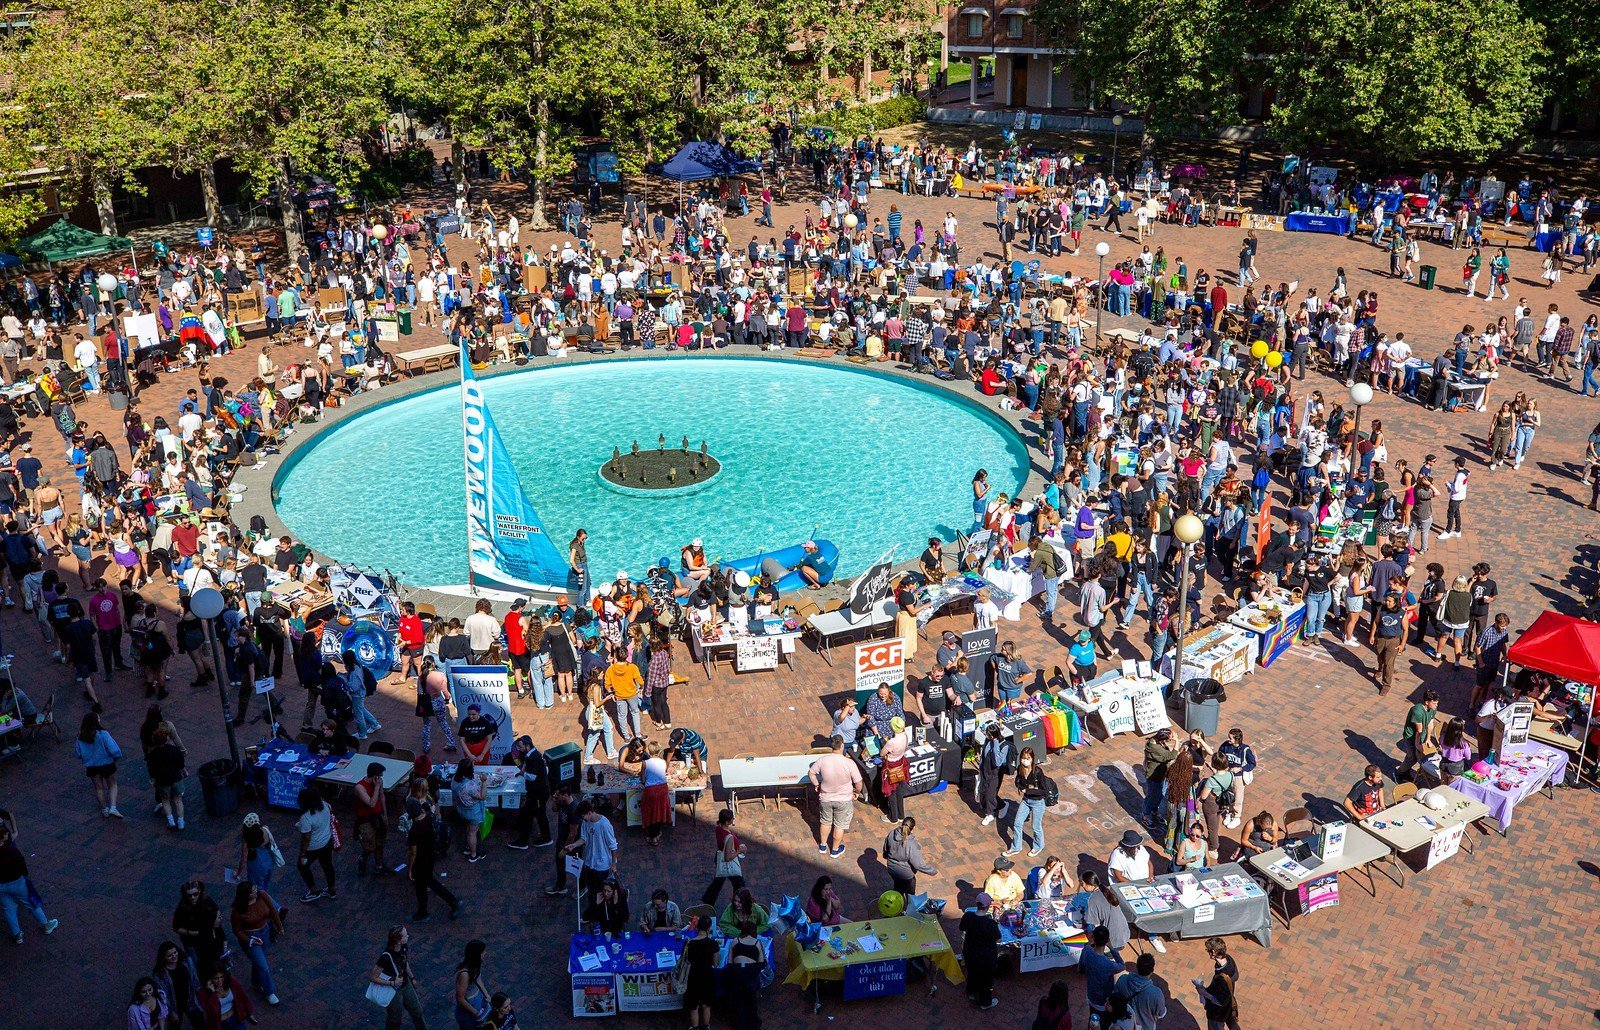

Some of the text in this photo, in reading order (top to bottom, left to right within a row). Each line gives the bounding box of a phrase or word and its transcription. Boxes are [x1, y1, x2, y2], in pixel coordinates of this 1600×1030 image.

[496, 514, 520, 523] WWU'S
[497, 522, 540, 533] WATERFRONT
[498, 530, 526, 539] FACILITY
[354, 586, 374, 597] Rec
[967, 638, 991, 650] love
[856, 643, 902, 670] CCF
[856, 667, 904, 682] CAMPUS CHRISTIAN
[457, 677, 504, 688] CHABAD
[856, 673, 904, 689] FELLOWSHIP
[460, 693, 504, 706] @WWU
[1022, 939, 1061, 959] PhIS
